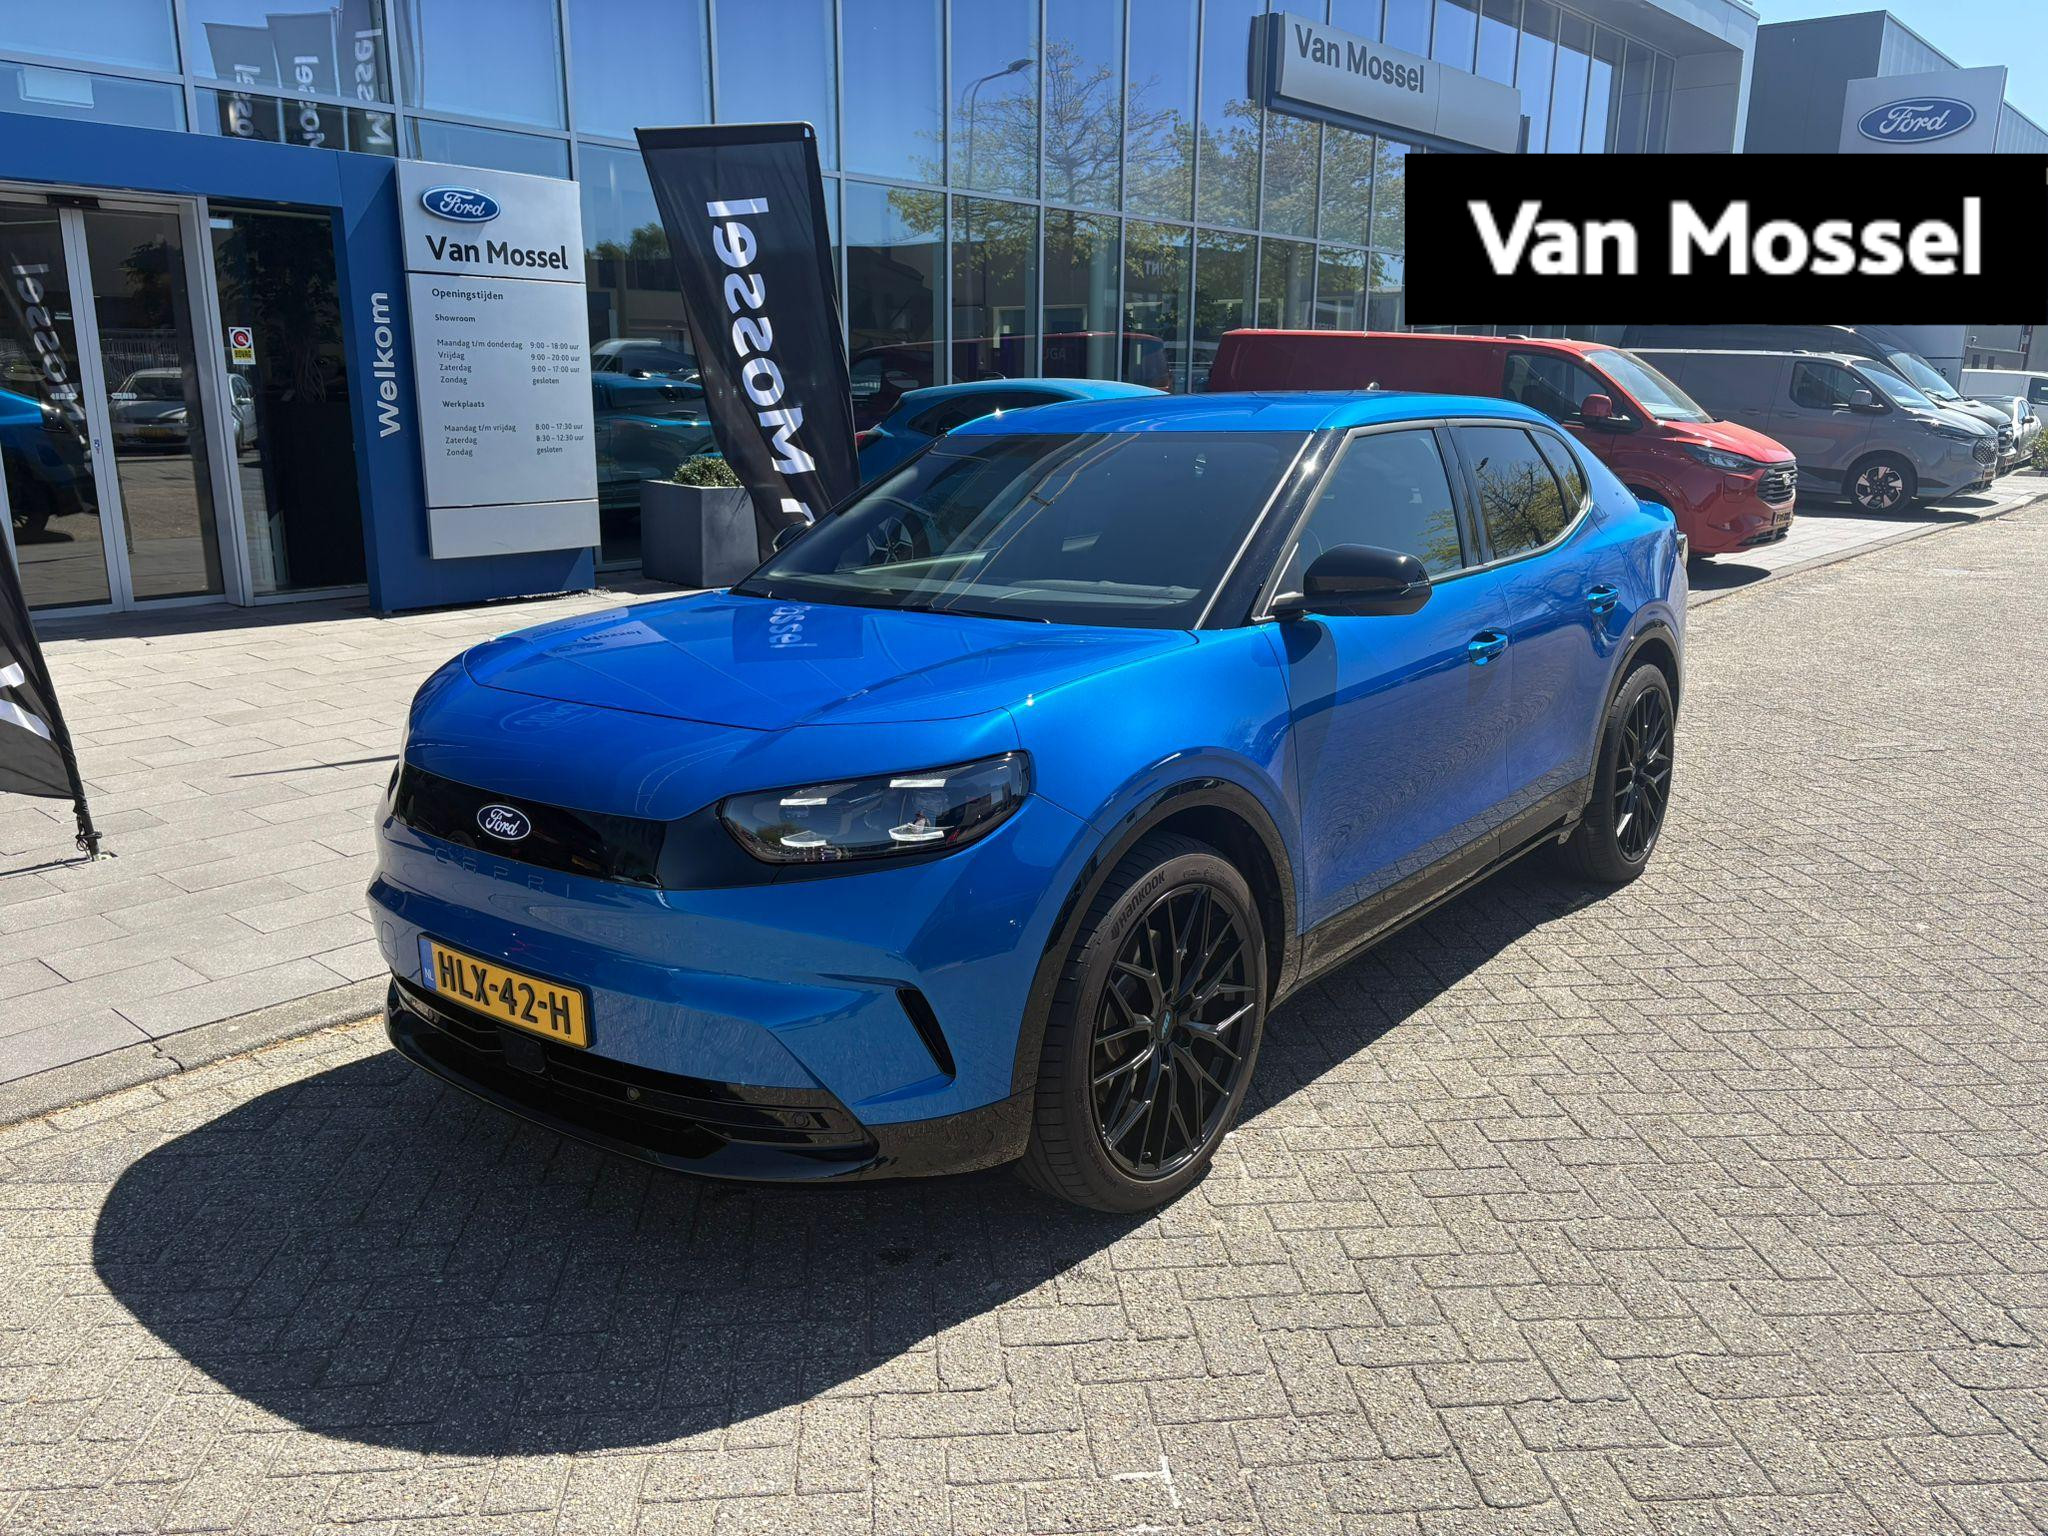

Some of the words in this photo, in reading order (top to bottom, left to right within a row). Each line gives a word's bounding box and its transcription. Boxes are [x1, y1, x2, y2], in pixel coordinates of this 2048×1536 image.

[1295, 24, 1340, 68] Van
[1347, 41, 1424, 93] Mossel
[1879, 105, 1951, 134] Ford
[440, 191, 485, 216] Ford
[425, 235, 480, 263] Van
[486, 240, 569, 270] Mossel
[431, 288, 504, 301] Openingstijden
[434, 313, 476, 322] Showroom
[436, 339, 470, 349] Maandag
[486, 339, 523, 350] donderdag
[551, 342, 568, 350] 18:00
[438, 352, 465, 361] Vrijdag
[552, 354, 570, 362] 20:00
[371, 292, 401, 438] Welkom
[440, 364, 472, 373] Zaterdag
[531, 365, 546, 373] 9:00
[440, 376, 468, 385] Zondag
[532, 377, 560, 386] gesloten
[442, 400, 485, 409] Werkplaats
[444, 424, 477, 433] Maandag
[478, 424, 492, 432] t/m
[493, 424, 517, 433] vrijdag
[535, 423, 550, 431] 8:00
[445, 436, 478, 446] Zaterdag
[556, 434, 573, 442] 12:30
[446, 448, 473, 458] Zondag
[536, 446, 562, 456] gesloten
[485, 808, 519, 836] Ford
[434, 846, 571, 898] CAPRI
[424, 967, 434, 982] NL
[438, 951, 571, 1036] HLX-42-H
